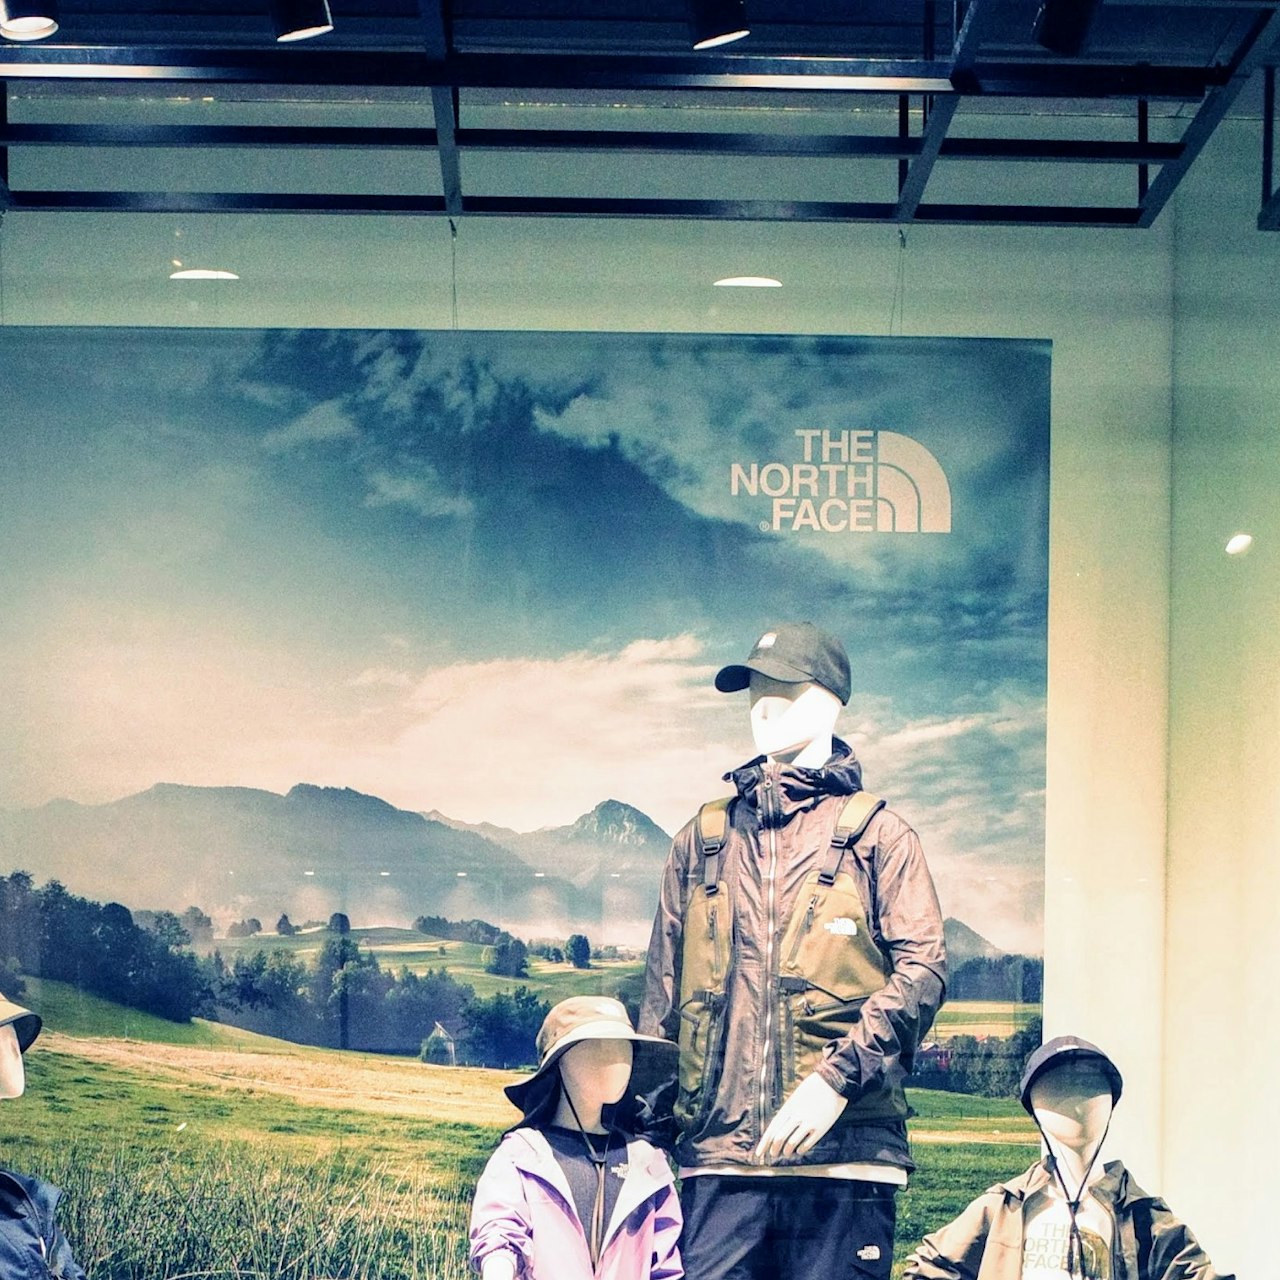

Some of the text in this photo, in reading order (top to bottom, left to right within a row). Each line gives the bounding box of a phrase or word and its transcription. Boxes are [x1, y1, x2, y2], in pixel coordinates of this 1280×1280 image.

[795, 429, 874, 463] THE
[730, 463, 874, 497] NORTH
[771, 498, 874, 532] FACE
